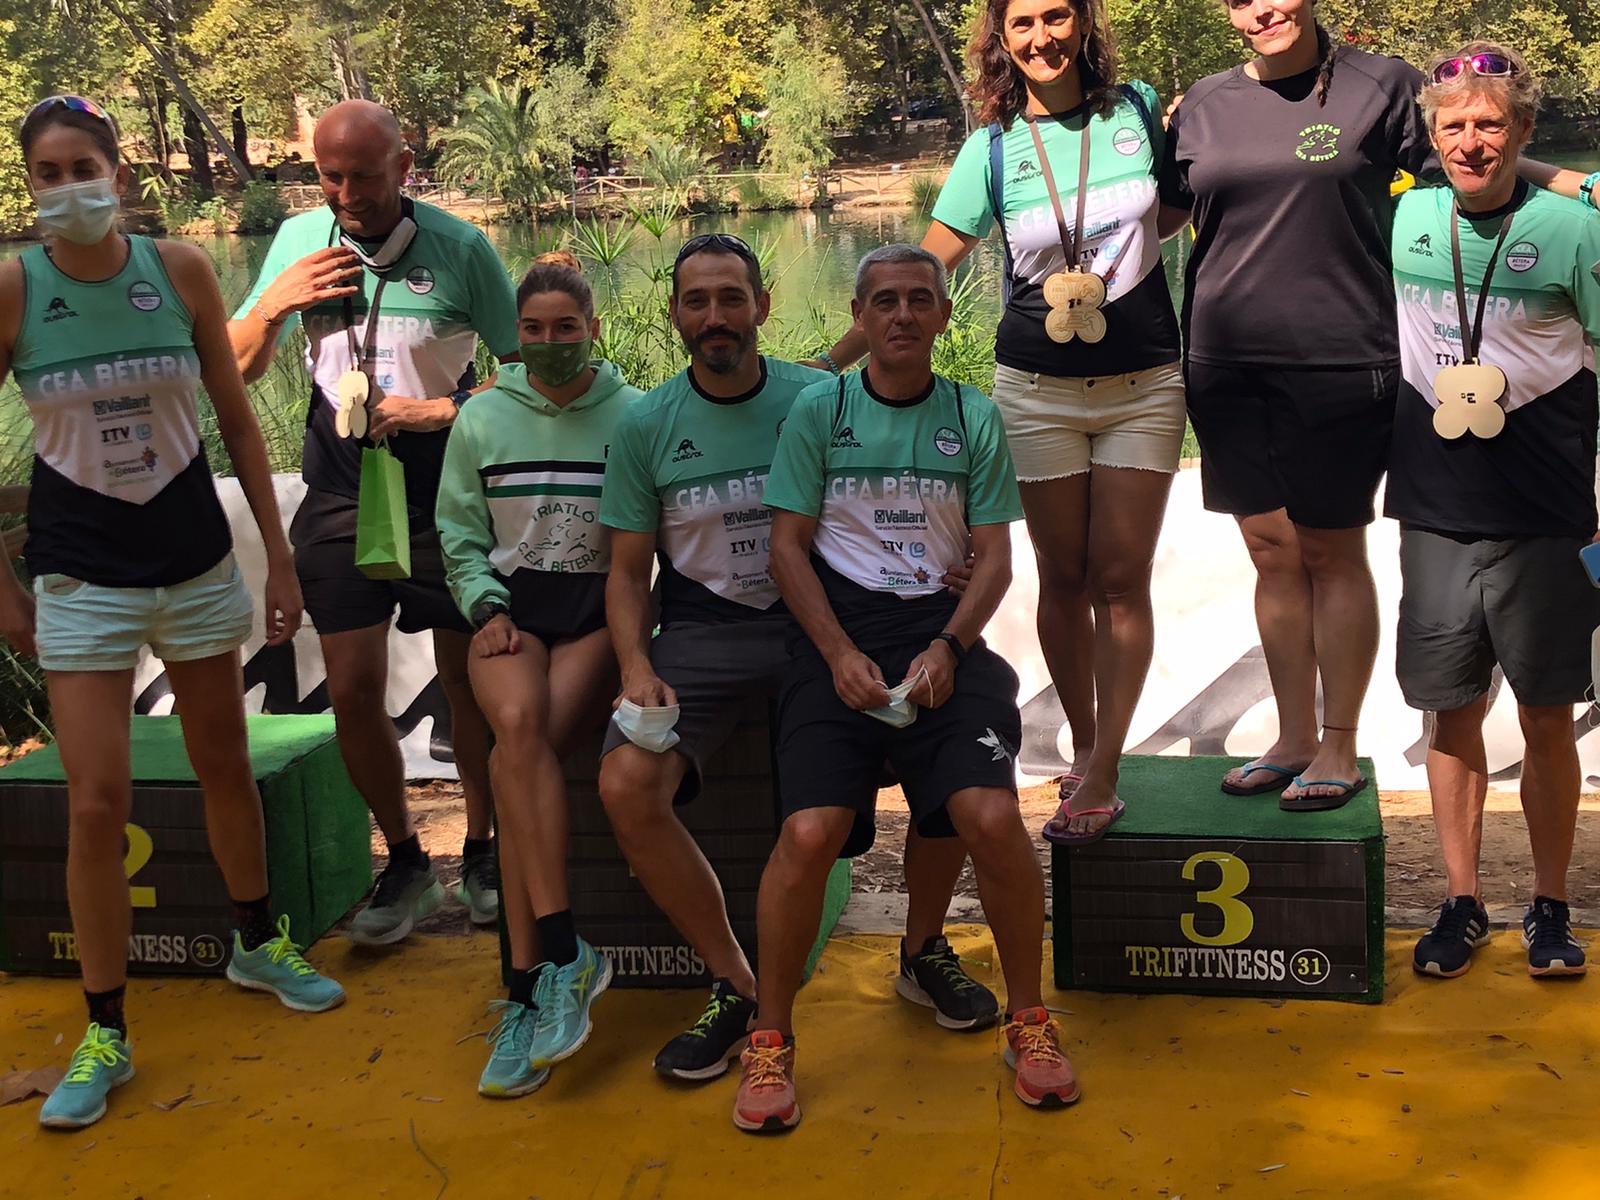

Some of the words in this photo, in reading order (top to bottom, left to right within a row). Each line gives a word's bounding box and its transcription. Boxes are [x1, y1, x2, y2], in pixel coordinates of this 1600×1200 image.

[1081, 247, 1099, 259] TV
[1403, 282, 1432, 306] CEA
[1435, 352, 1460, 367] ITV
[39, 368, 88, 397] CEA
[95, 354, 194, 389] BÉTERA
[101, 426, 130, 443] ITV
[675, 483, 721, 512] CEA
[727, 470, 770, 502] BÉT
[831, 476, 874, 501] CEA
[735, 508, 773, 523] Vaillan
[885, 509, 928, 524] Vaillant
[730, 538, 757, 554] ITV
[880, 540, 904, 552] ITV
[122, 822, 156, 908] 2
[1180, 850, 1255, 947] 3
[48, 931, 188, 964] TRNESS
[195, 941, 218, 959] 31
[594, 945, 705, 977] FITNESS
[1125, 945, 1287, 982] TRIFITNESS
[1297, 956, 1322, 976] 31
